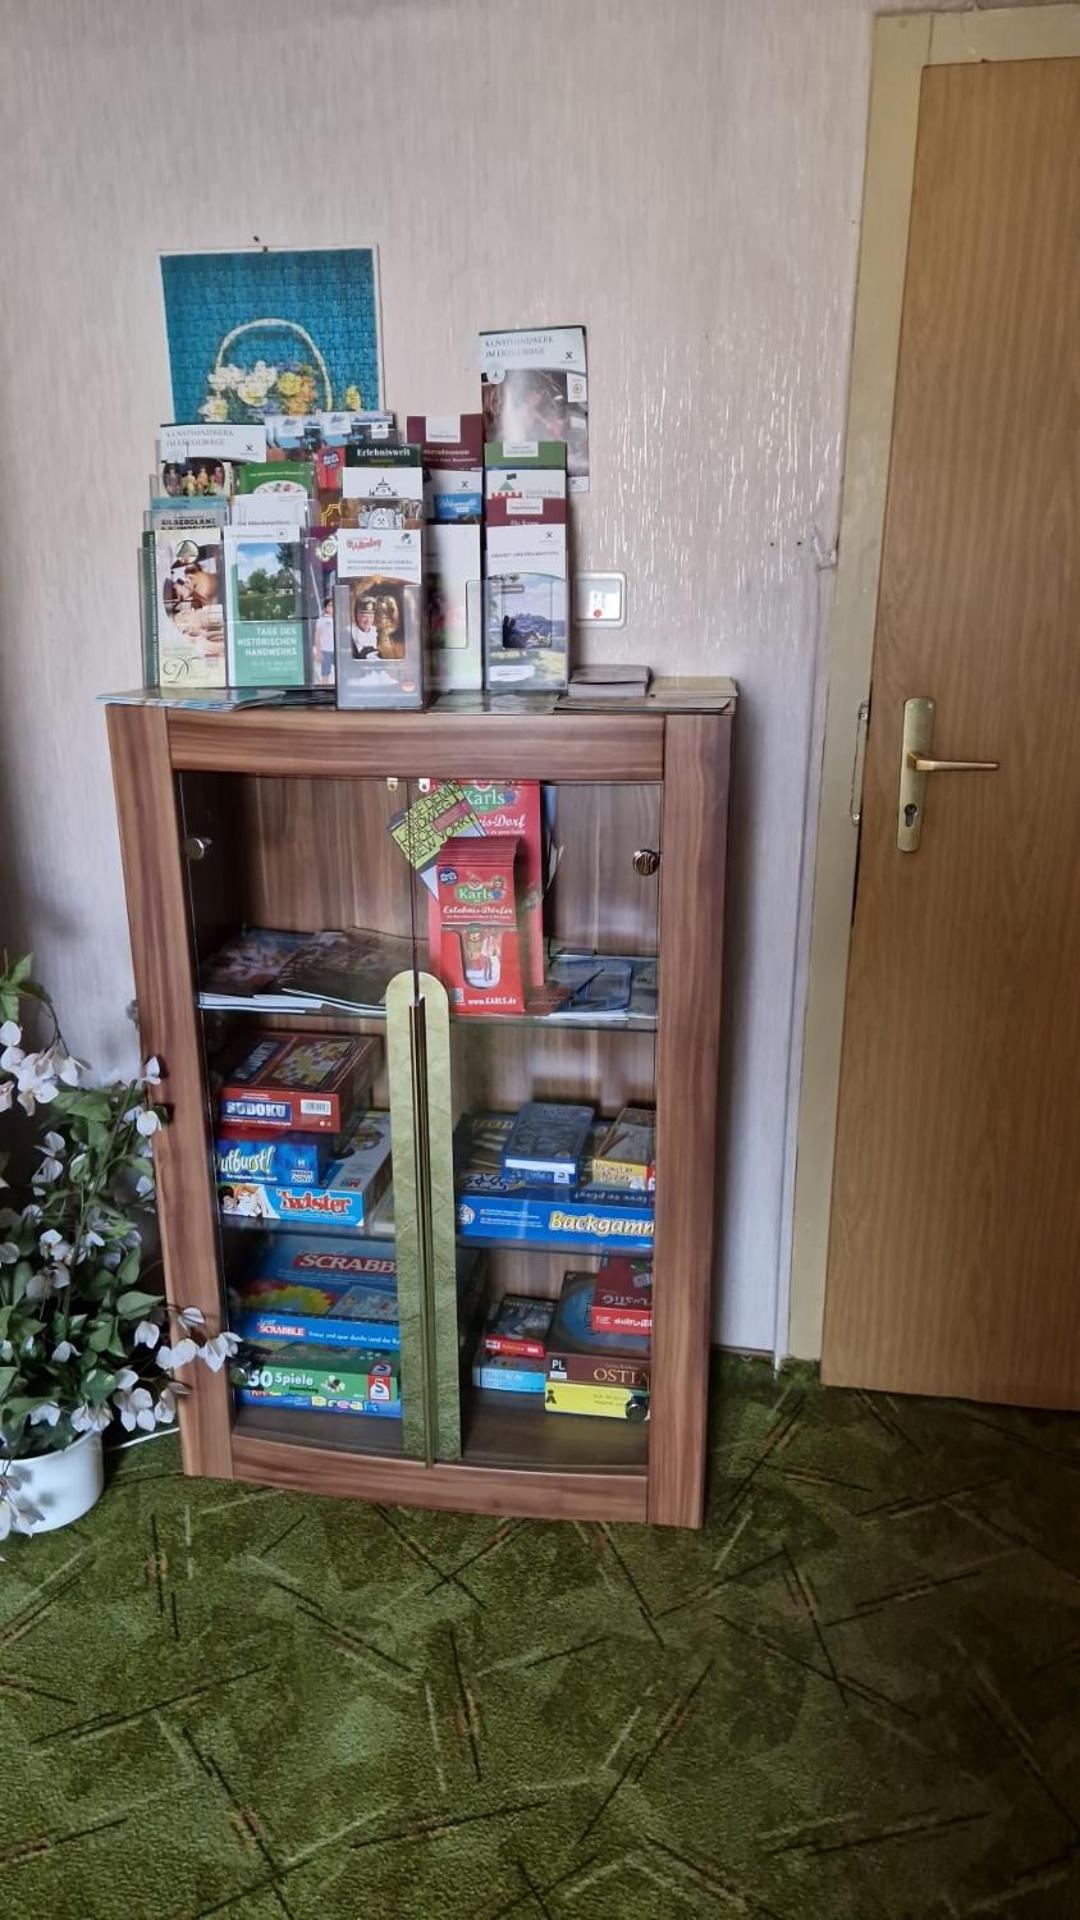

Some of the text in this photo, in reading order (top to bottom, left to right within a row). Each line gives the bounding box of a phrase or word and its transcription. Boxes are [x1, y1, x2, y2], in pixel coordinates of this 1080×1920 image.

[256, 627, 297, 636] TAGE DES
[237, 637, 297, 646] HISTORISCHEN
[245, 647, 297, 656] HANDWERKS
[459, 888, 493, 900] Karls
[226, 1102, 286, 1117] SUDOKU
[221, 1144, 276, 1174] utburst!
[276, 1189, 352, 1213] Twister
[549, 1210, 655, 1236] Backgamm
[300, 1254, 396, 1273] SCRABB
[260, 1324, 304, 1336] SCRABBLE
[552, 1359, 566, 1371] PL
[274, 1372, 314, 1386] Spiele
